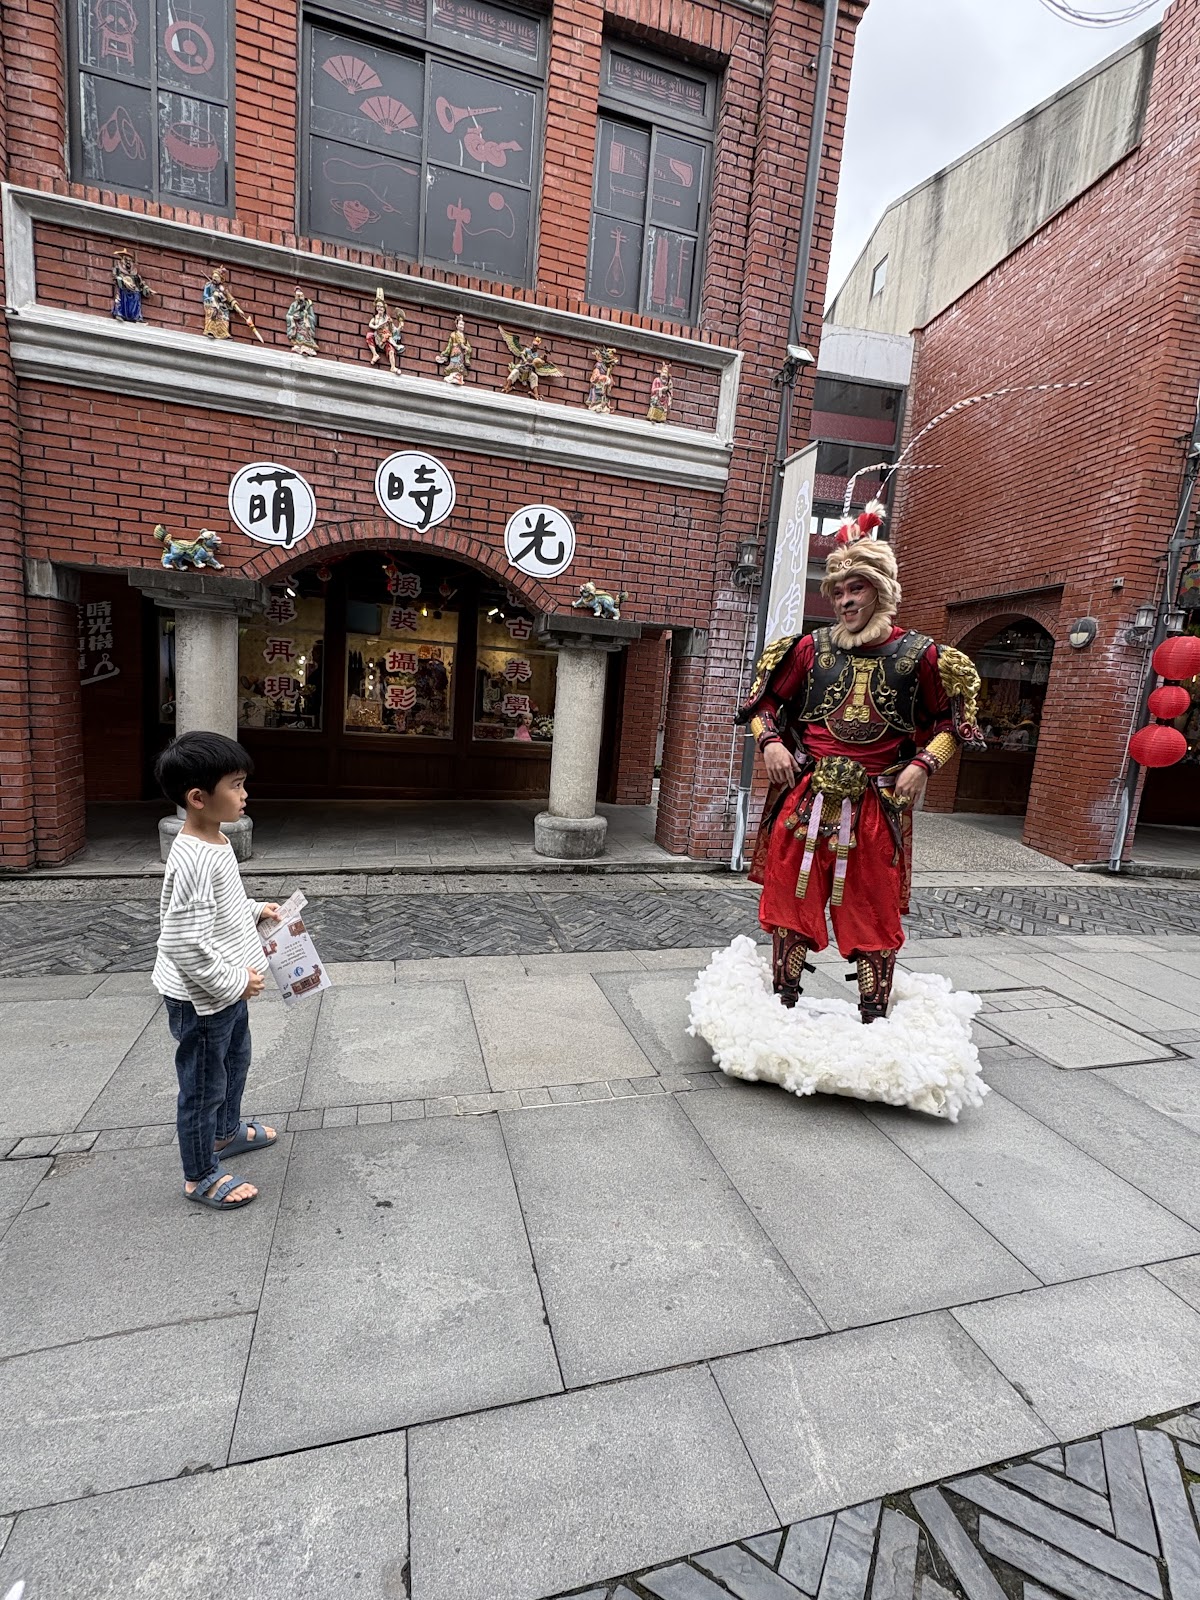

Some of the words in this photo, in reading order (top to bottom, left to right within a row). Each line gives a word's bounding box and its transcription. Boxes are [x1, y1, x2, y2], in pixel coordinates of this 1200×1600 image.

[86, 600, 114, 651] 時光機
[386, 573, 420, 709] 換裝攝影
